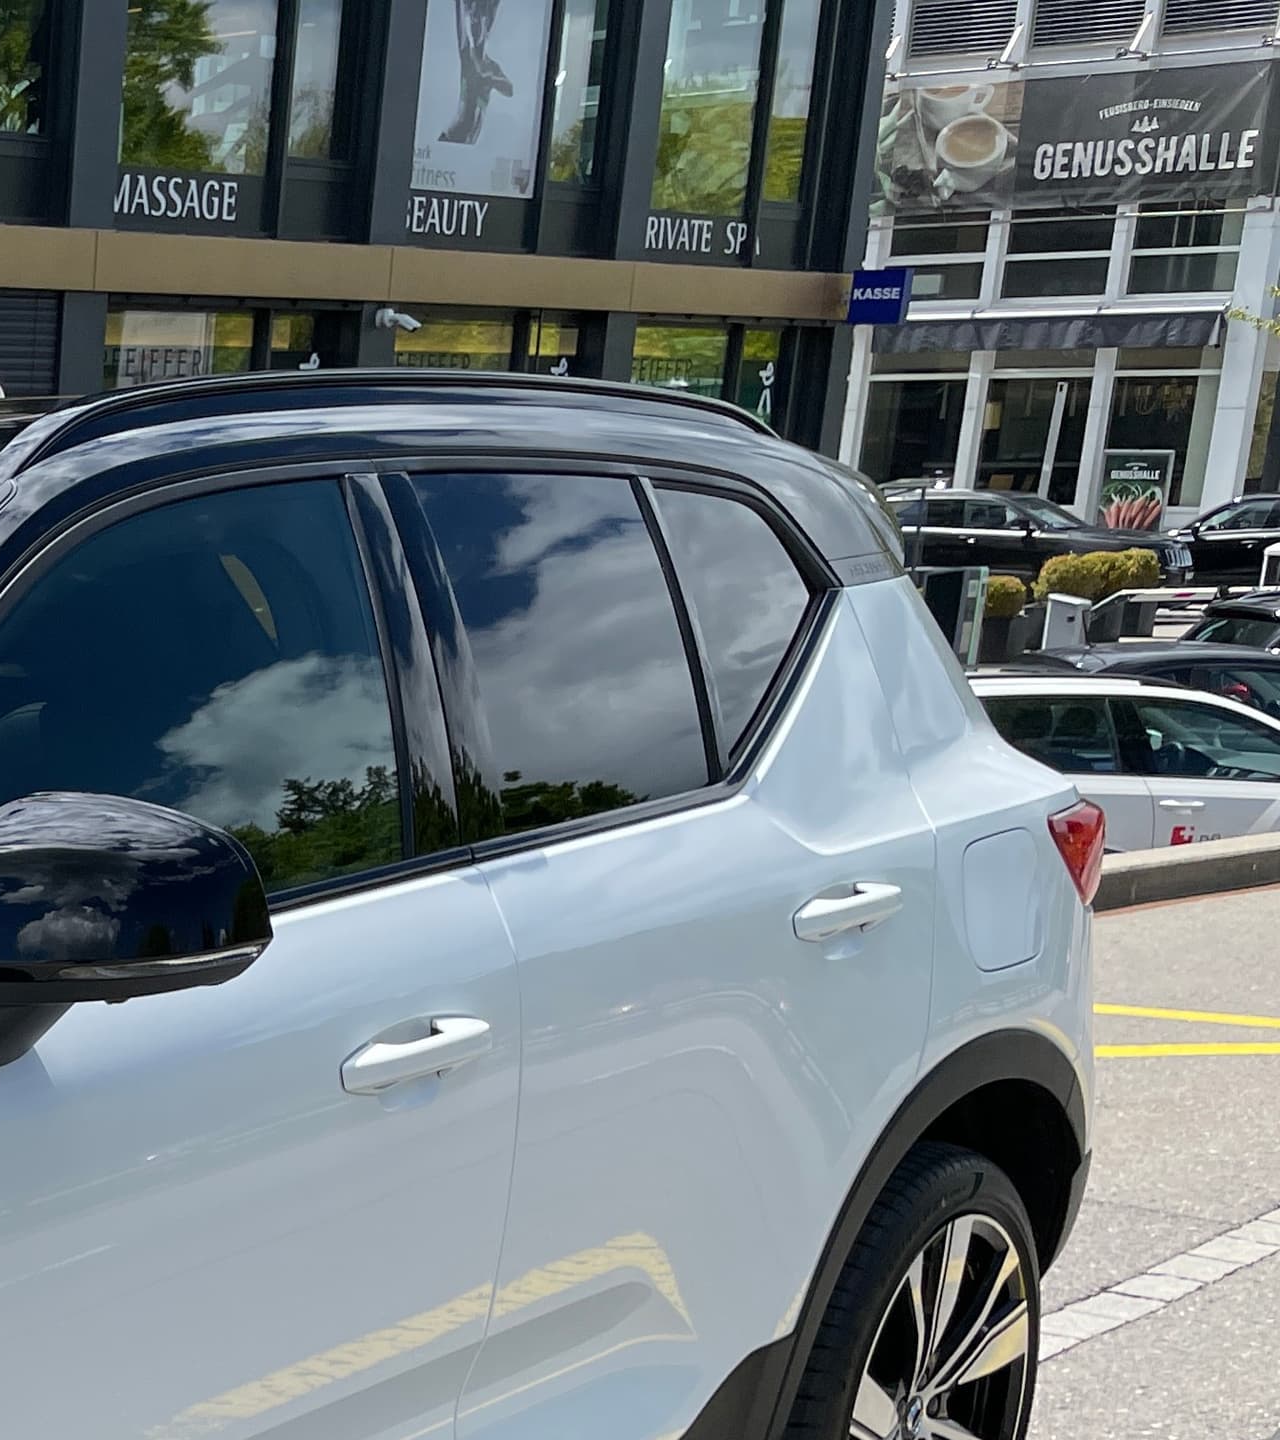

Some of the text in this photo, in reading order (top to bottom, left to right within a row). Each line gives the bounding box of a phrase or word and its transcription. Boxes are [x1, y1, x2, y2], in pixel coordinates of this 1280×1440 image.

[1032, 129, 1259, 181] GENUSSHALLE
[113, 173, 238, 221] MASSAGE
[644, 215, 714, 253] RIVATE
[852, 287, 902, 301] KASSE
